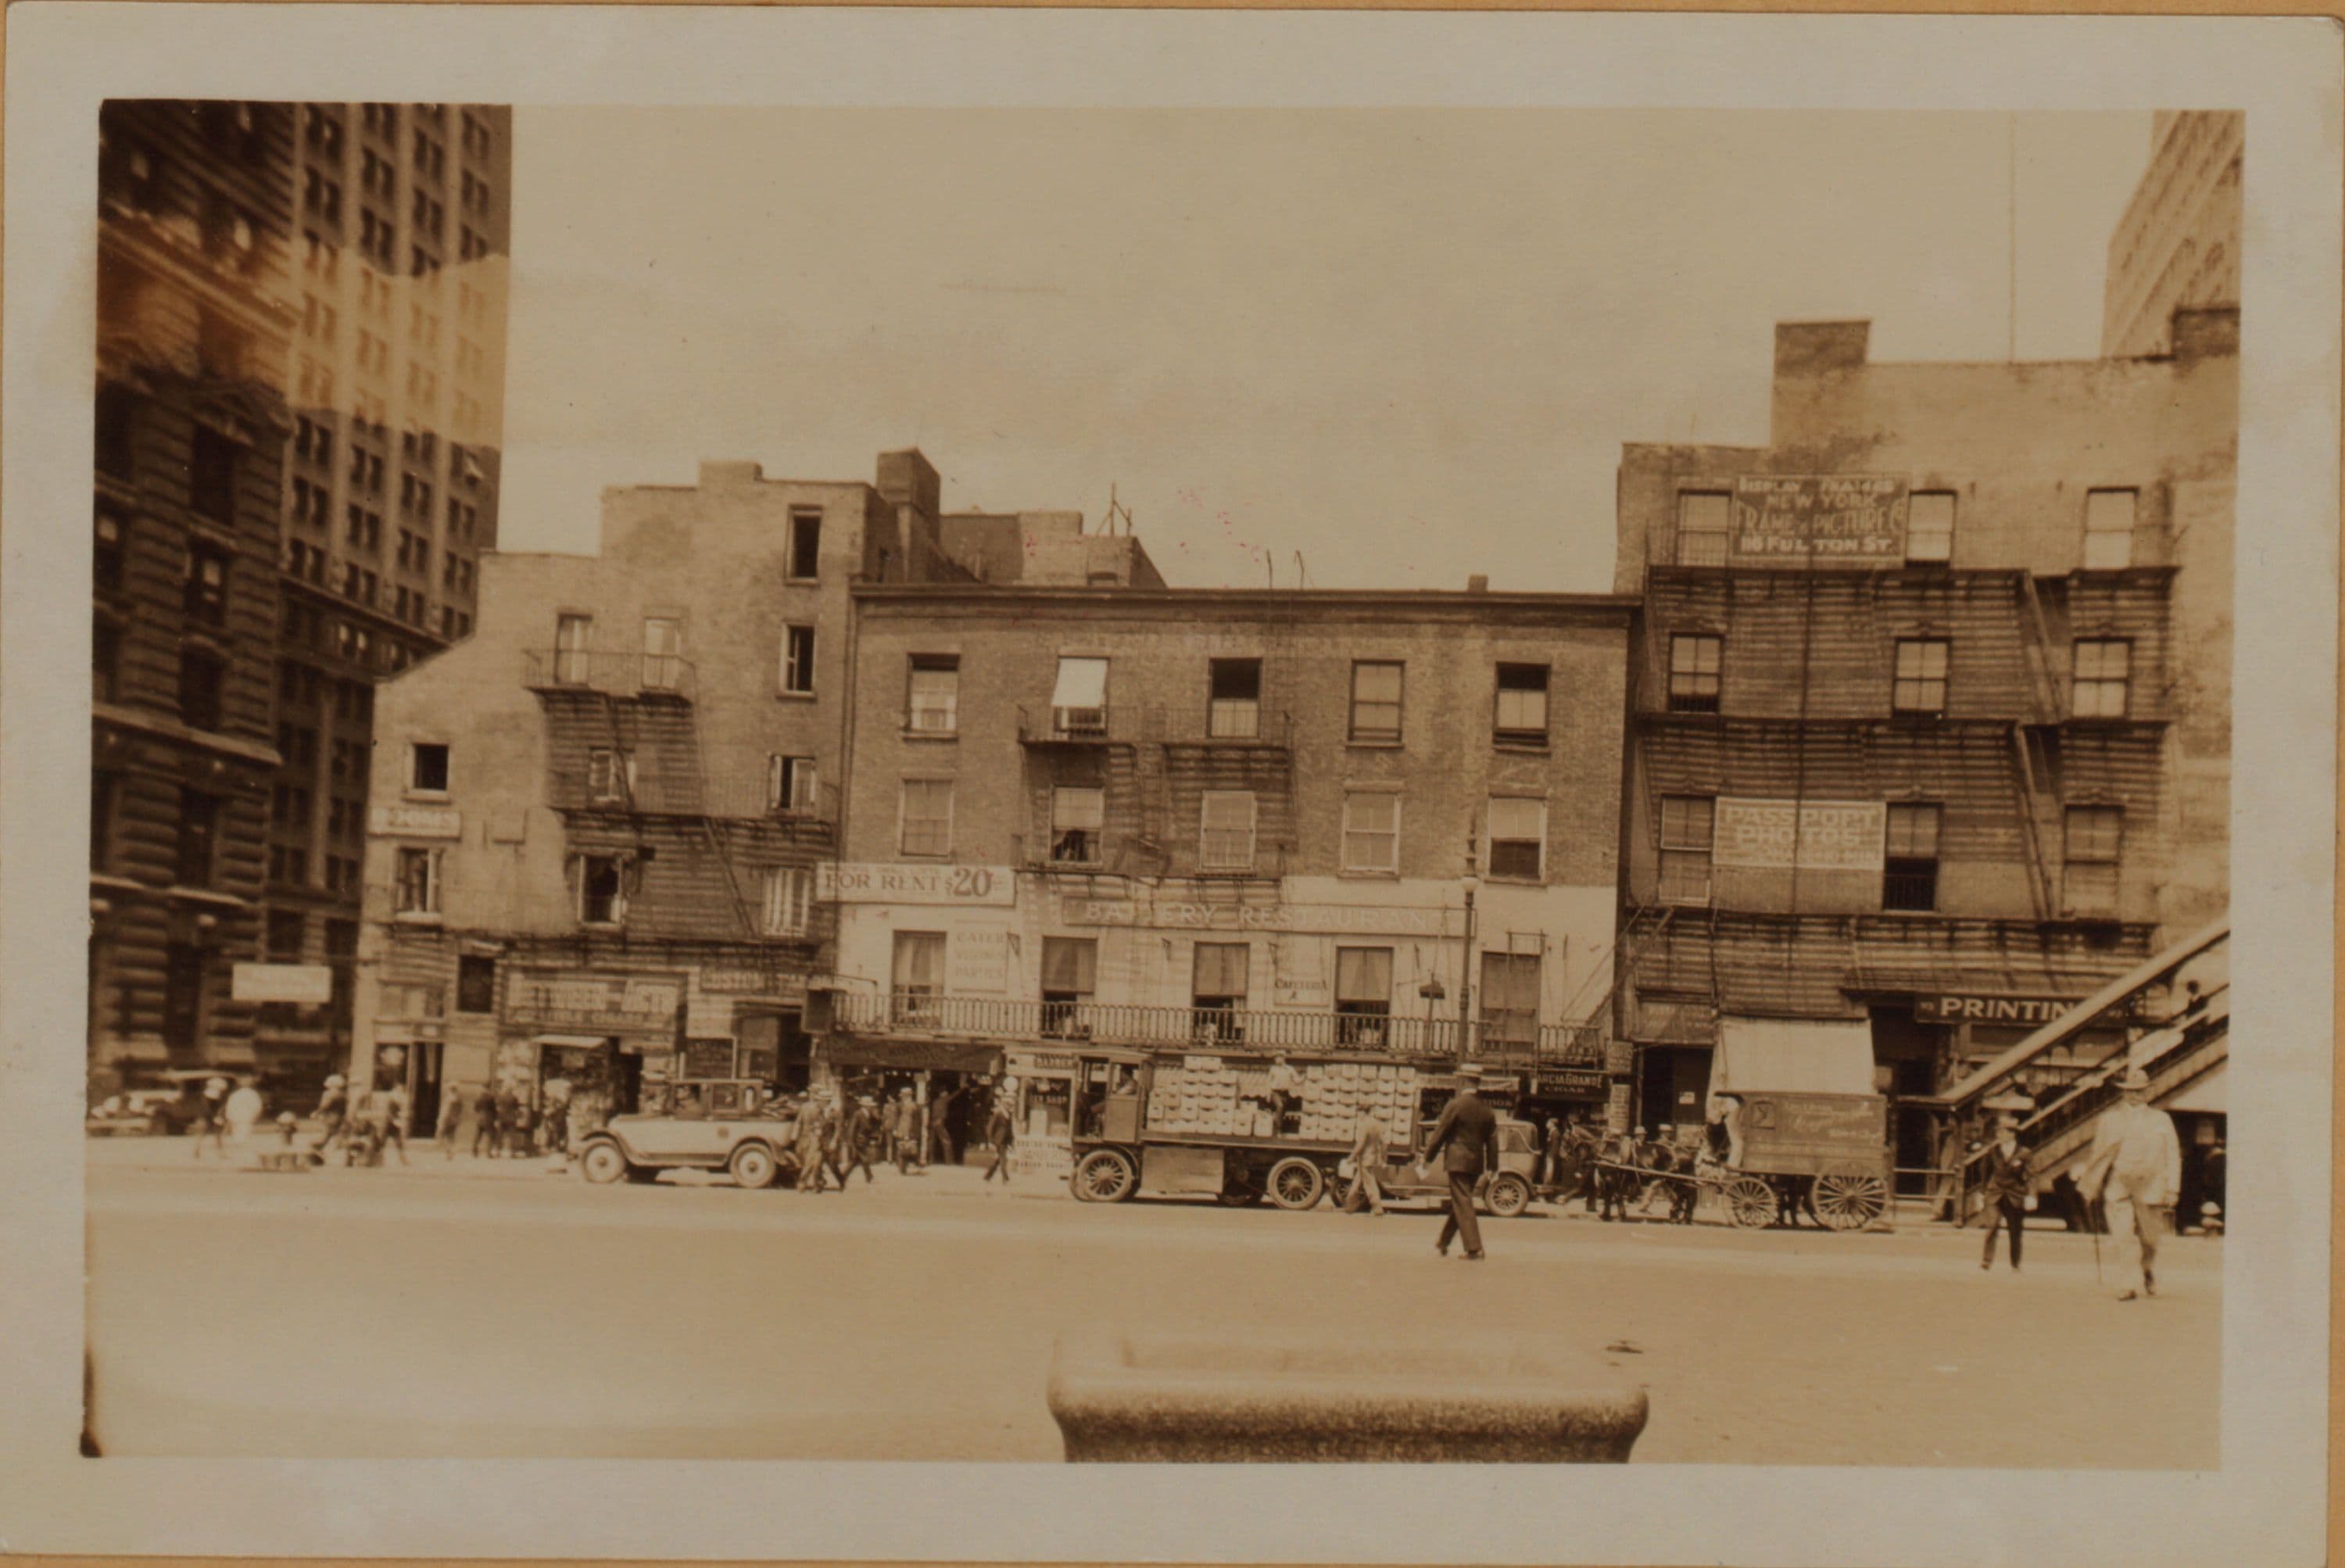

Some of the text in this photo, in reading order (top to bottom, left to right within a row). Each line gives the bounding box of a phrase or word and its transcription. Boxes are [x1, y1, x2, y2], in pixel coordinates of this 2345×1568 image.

[1766, 492, 1878, 510] NEW YORK
[1736, 499, 1795, 535] FRAME
[1767, 536, 1859, 553] FULTON
[1726, 807, 1879, 830] PASSPORT
[1736, 825, 1861, 847] PHOTOS
[824, 872, 871, 890] FOR
[882, 874, 940, 891] RENT
[1086, 903, 1452, 931] BAERY RESTAURANT
[1274, 979, 1327, 990] CAFETERIA
[1940, 997, 2079, 1021] PRINTIN
